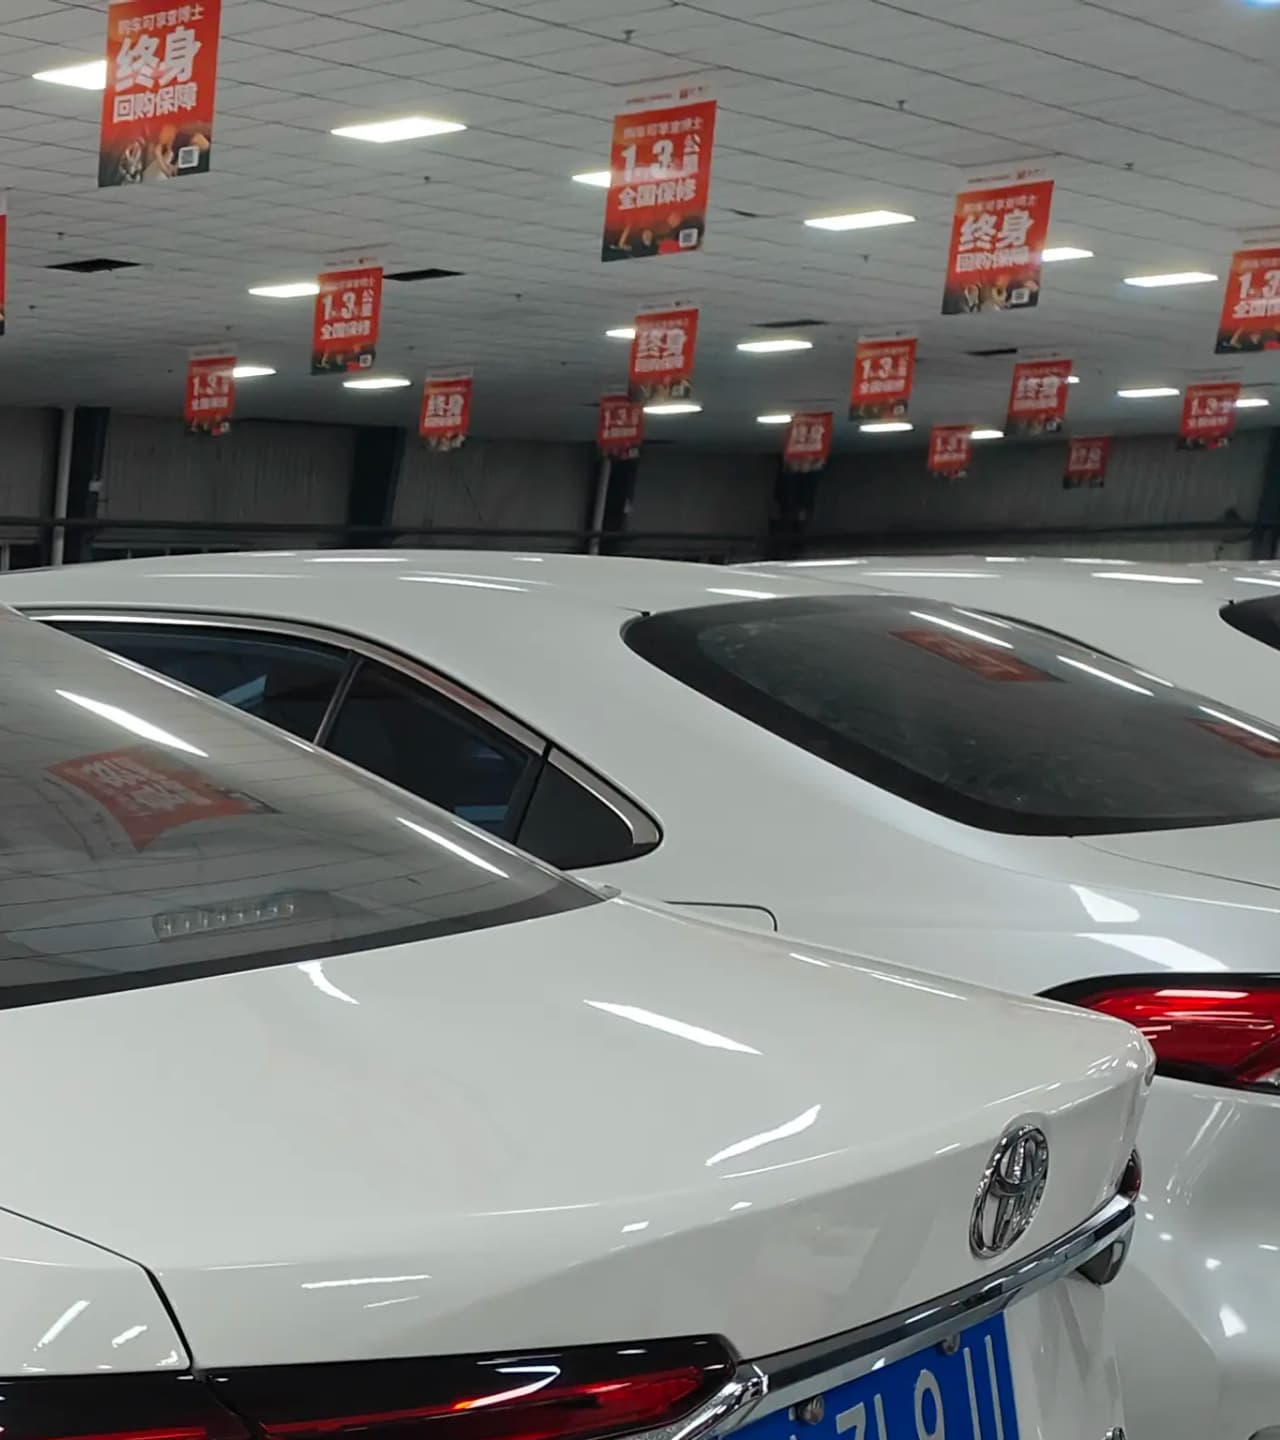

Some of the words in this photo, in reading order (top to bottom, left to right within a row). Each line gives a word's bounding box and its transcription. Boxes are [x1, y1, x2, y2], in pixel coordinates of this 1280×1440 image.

[116, 26, 202, 92] 终身
[113, 83, 197, 122] 回购保障
[618, 178, 696, 210] 全国保修
[958, 208, 1034, 252] 终身
